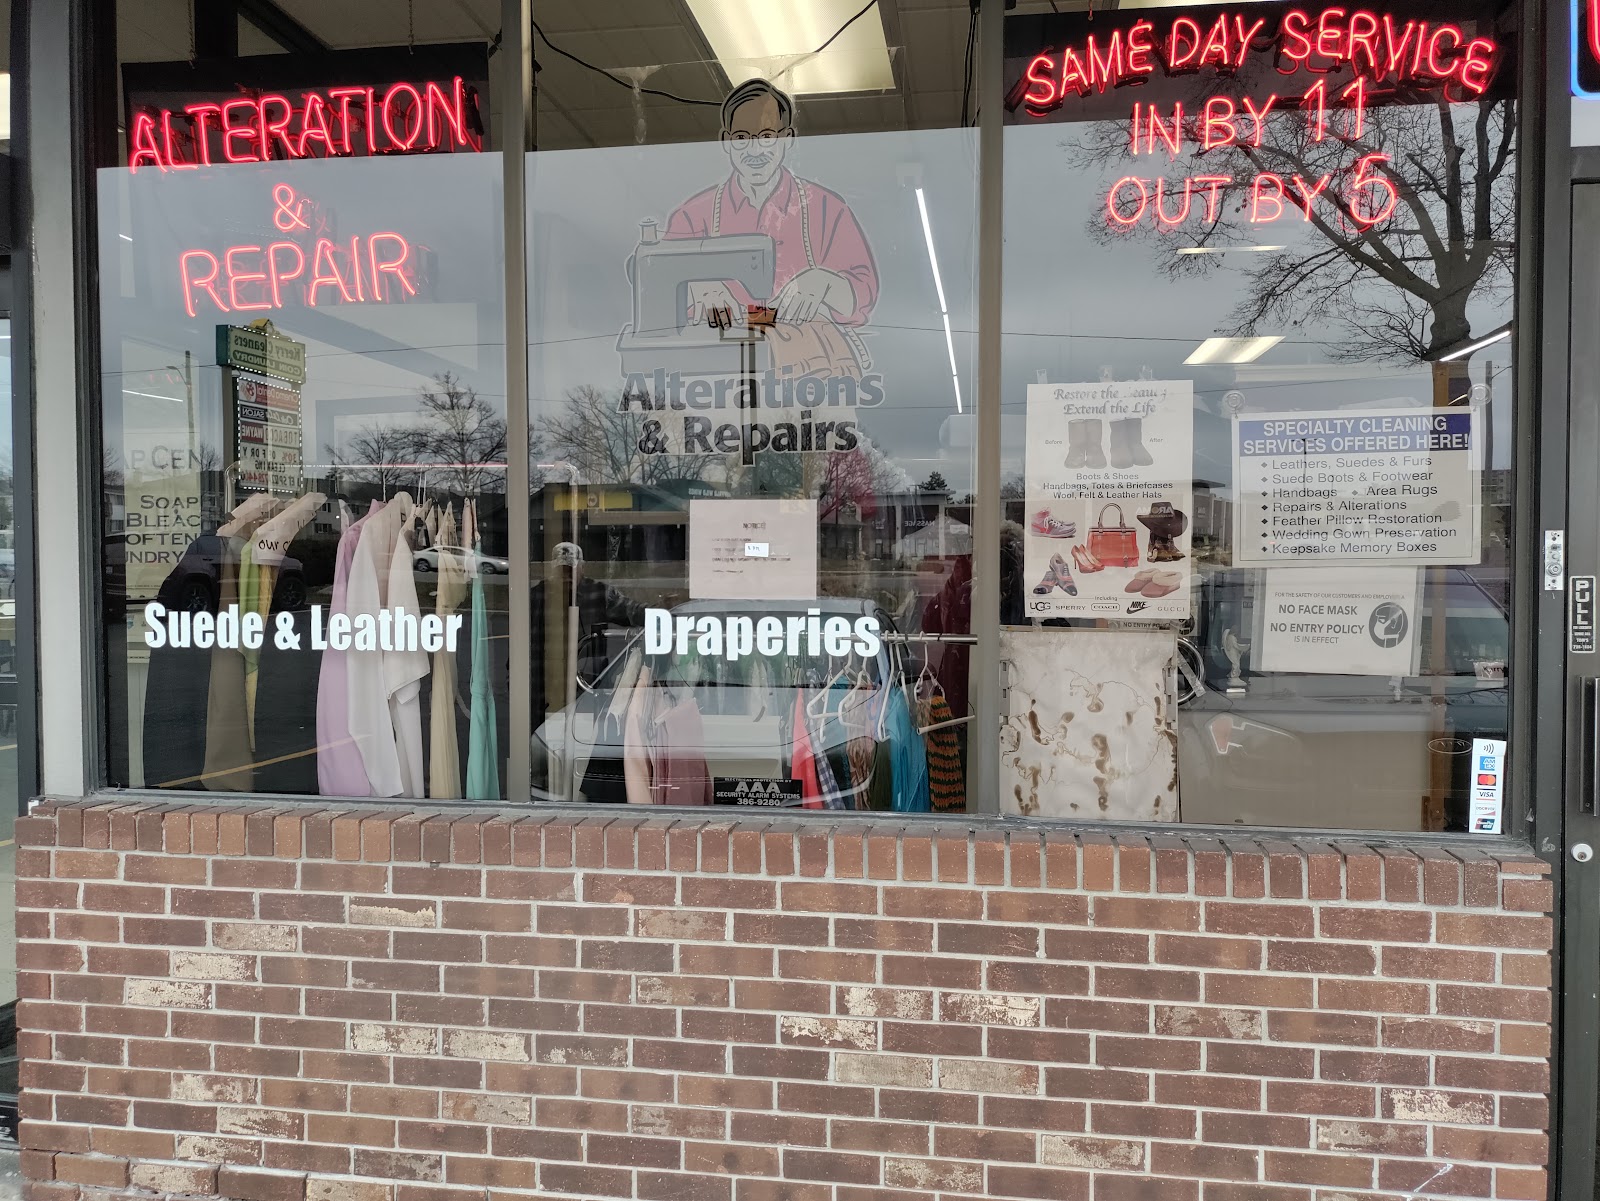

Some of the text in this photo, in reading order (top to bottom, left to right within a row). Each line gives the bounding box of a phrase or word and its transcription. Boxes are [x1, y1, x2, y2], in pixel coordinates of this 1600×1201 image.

[1025, 21, 1153, 104] SAME
[1169, 14, 1265, 67] DAY
[1284, 9, 1496, 95] SERVICE
[1133, 77, 1365, 156] IN BY 11
[130, 76, 468, 174] ALTERATION
[1107, 153, 1398, 225] OUT BY 5
[272, 183, 310, 233] &
[180, 232, 417, 318] REPAIR
[618, 365, 885, 412] Alterations
[1054, 388, 1098, 400] Restore
[1101, 384, 1119, 399] the
[1063, 399, 1157, 419] Extend the Life
[1263, 416, 1447, 437] SPECIALTY CLEANING
[638, 410, 858, 466] & Repairs
[1243, 433, 1469, 455] SERVICES OFFERED HERE!
[1272, 455, 1432, 471] Leathers, Suedes & Furs
[1076, 472, 1101, 480] Boots
[1112, 472, 1139, 480] Shoes
[1272, 470, 1434, 485] Suede Boots & Footwear
[1043, 482, 1089, 491] Handbags,
[1272, 484, 1438, 500] Handbags Area Rugs
[140, 494, 199, 510] SOAP
[1053, 491, 1163, 500] Wool, Felt & Leather Hats
[1273, 499, 1407, 514] Repairs & Alterations
[126, 512, 201, 528] BLEAC
[1273, 513, 1442, 527] Feather Pillow Restoration
[125, 532, 198, 546] OFTEN
[1272, 526, 1457, 542] Wedding Gown Preservation
[258, 539, 279, 551] our
[1272, 541, 1437, 556] Keepsake Memory Boxes
[1030, 601, 1051, 611] UGG
[1130, 600, 1147, 609] NIKE
[1278, 604, 1358, 616] NO FACE MASK
[1575, 580, 1590, 625] PULL
[144, 602, 463, 653] Suede & Leather
[644, 608, 881, 662] Draperies
[1270, 622, 1365, 634] NO ENTRY POLICY
[1293, 635, 1301, 643] IS
[1311, 636, 1340, 644] EFFECT
[734, 781, 781, 794] AAA
[736, 798, 781, 806] 386-9280
[771, 792, 801, 800] SYSTEMS
